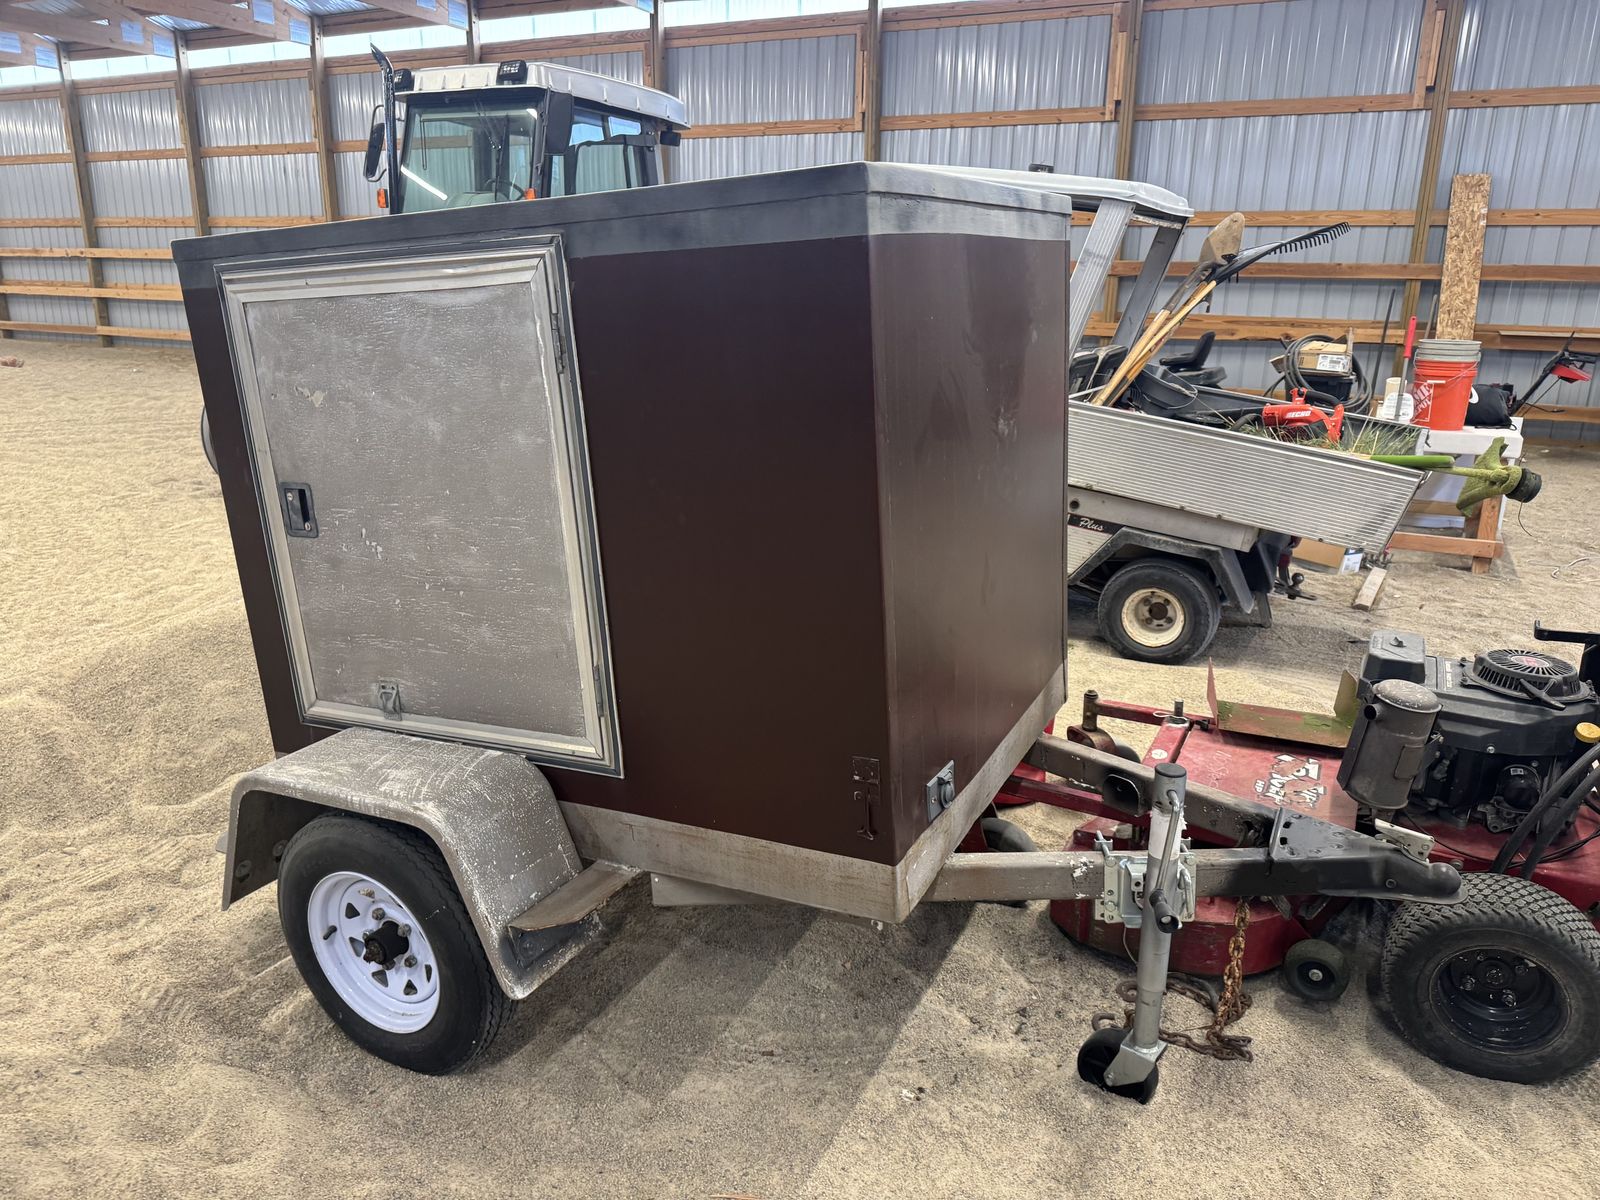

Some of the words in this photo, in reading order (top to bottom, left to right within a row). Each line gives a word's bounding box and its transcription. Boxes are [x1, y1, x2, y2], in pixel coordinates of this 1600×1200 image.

[1290, 410, 1311, 418] ECHO
[1079, 518, 1104, 531] Plus
[1254, 779, 1265, 793] HP
